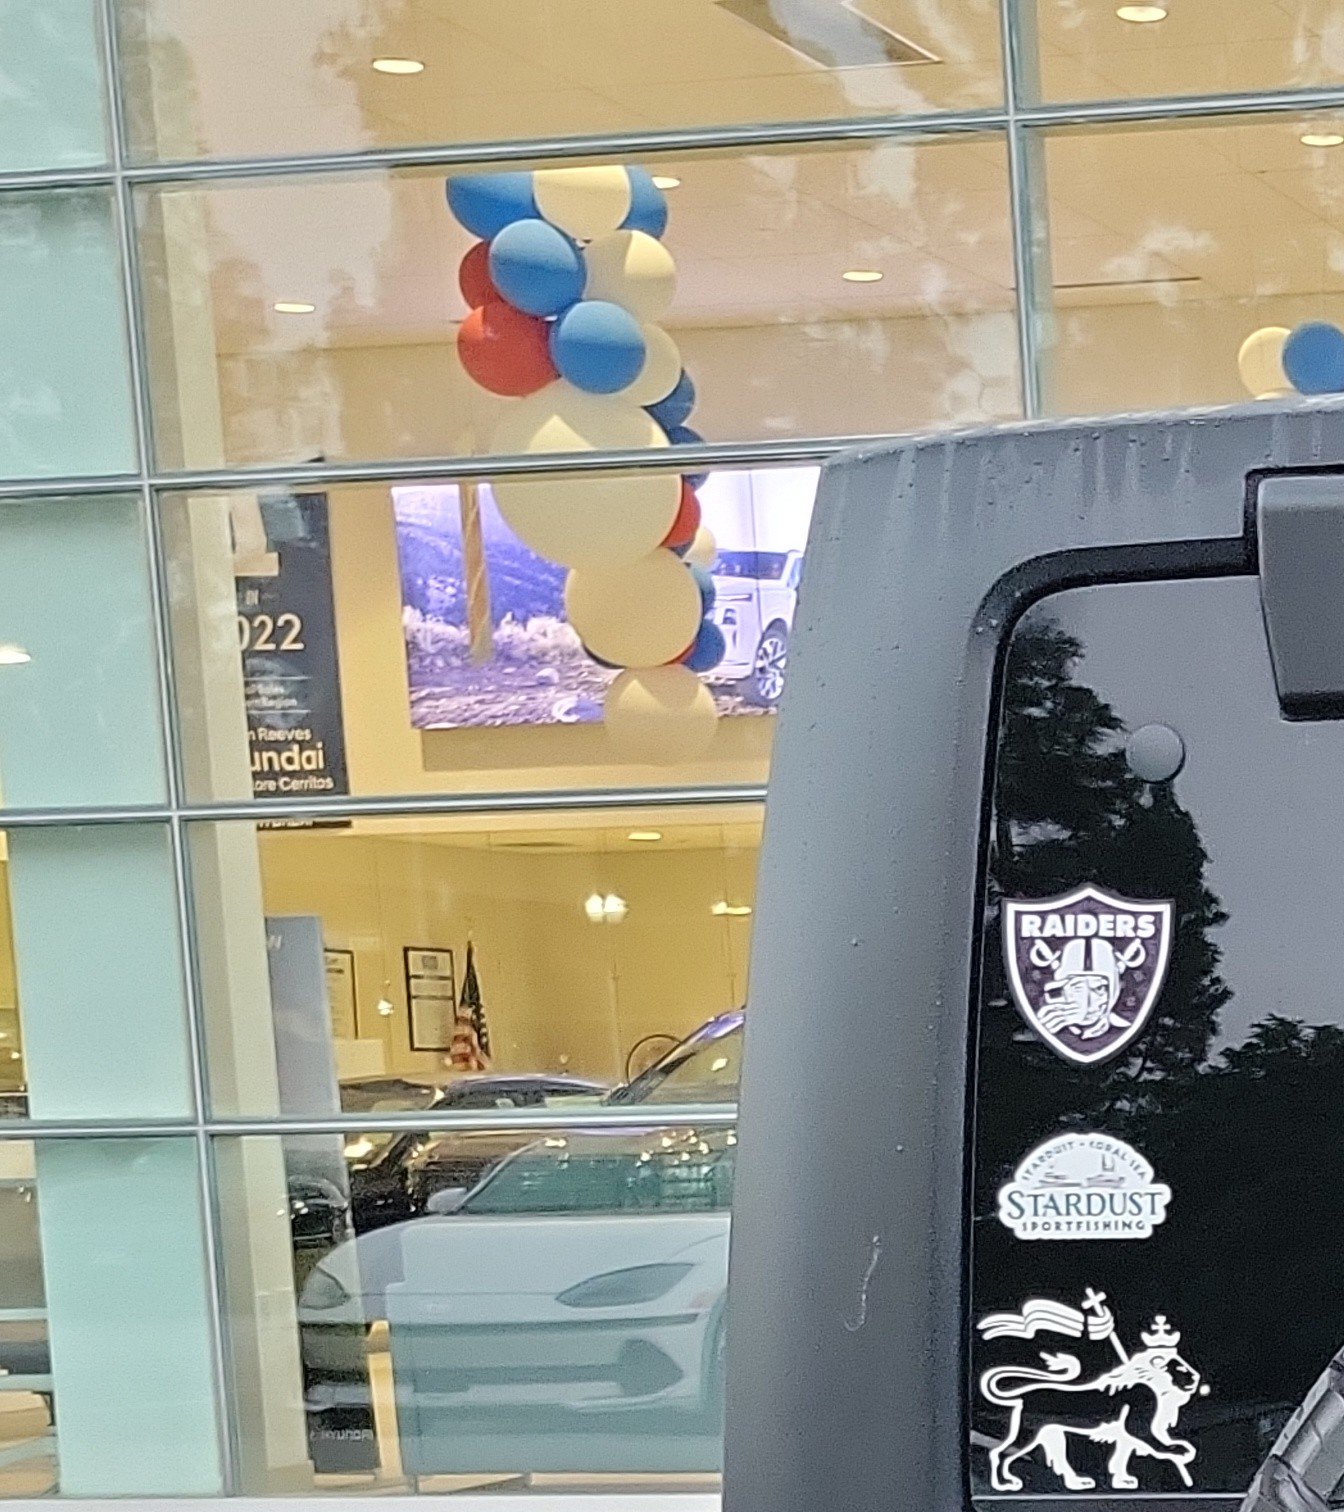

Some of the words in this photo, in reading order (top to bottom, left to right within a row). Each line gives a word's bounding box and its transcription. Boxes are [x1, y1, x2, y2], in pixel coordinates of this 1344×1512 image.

[237, 612, 305, 651] 022
[250, 741, 324, 772] undai
[1020, 913, 1156, 939] RAIDERS
[1007, 1190, 1164, 1220] STARDUST
[1022, 1219, 1146, 1232] SPORTFISHING
